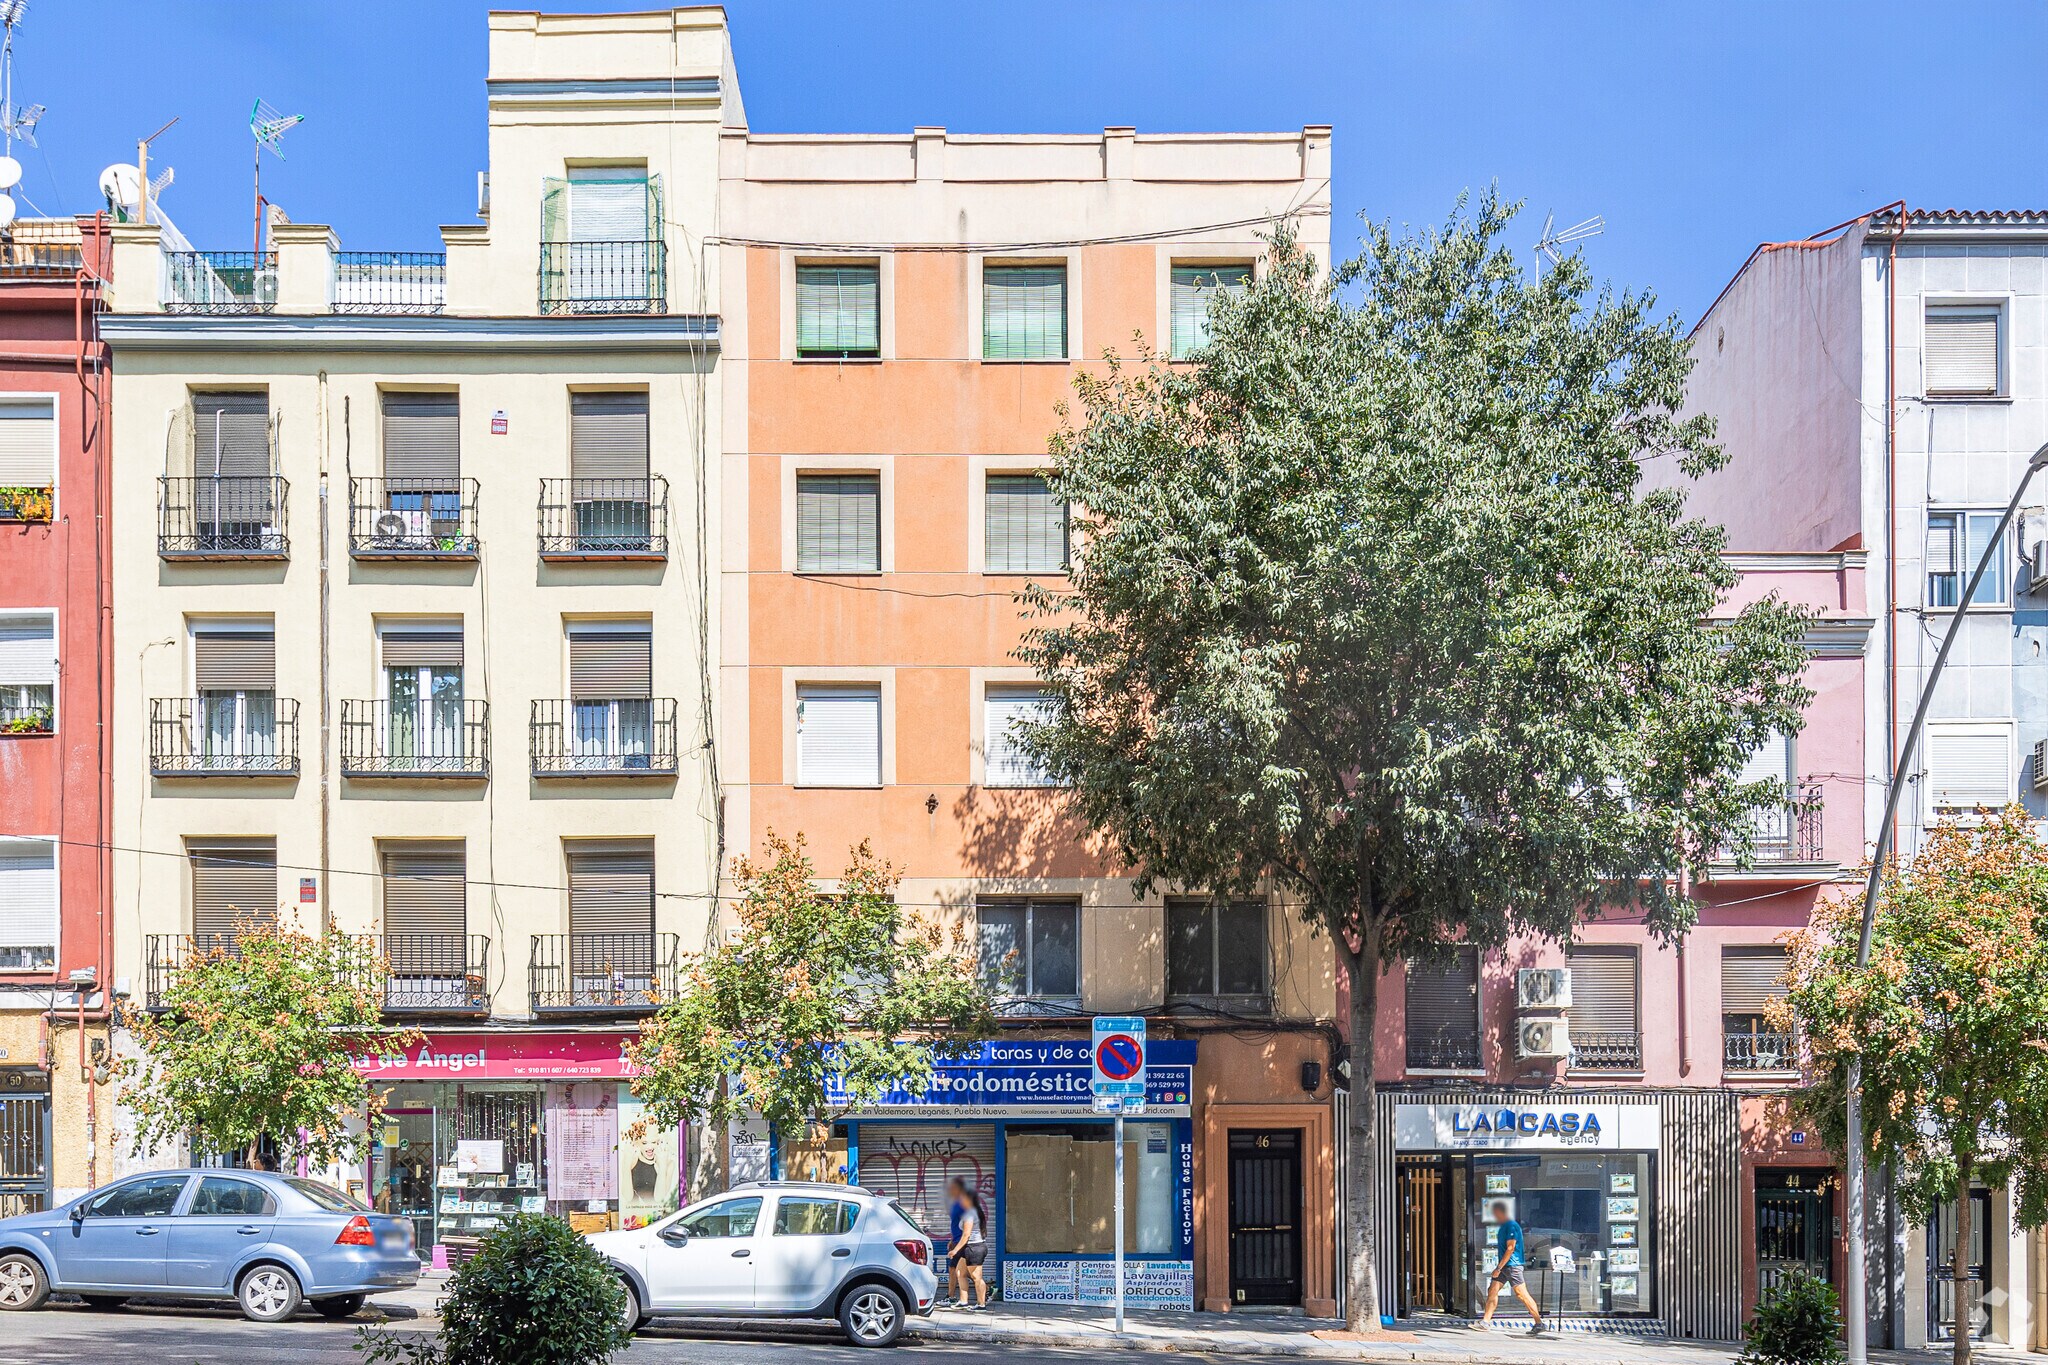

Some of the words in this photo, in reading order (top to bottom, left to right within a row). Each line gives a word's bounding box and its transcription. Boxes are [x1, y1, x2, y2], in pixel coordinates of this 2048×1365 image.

[415, 1045, 485, 1072] Ángel
[991, 1046, 1033, 1060] taras
[1038, 1049, 1047, 1063] y
[1052, 1045, 1073, 1060] de
[10, 1075, 21, 1086] 50
[1016, 1094, 1094, 1102] www.housefactorymad
[874, 1107, 915, 1116] Valdemoro,
[918, 1107, 951, 1117] Leganés,
[954, 1107, 981, 1115] Pueblo
[1454, 1112, 1493, 1133] LA
[1518, 1112, 1601, 1133] CASA
[1256, 1135, 1270, 1148] 46
[1560, 1135, 1600, 1146] agency
[1792, 1134, 1803, 1142] 44
[1180, 1143, 1192, 1183] House
[1785, 1174, 1800, 1187] 44
[1182, 1188, 1192, 1245] Factory
[1124, 1271, 1194, 1281] Lavavajillas
[1005, 1291, 1074, 1300] Secadoras
[1099, 1286, 1181, 1296] FRIORÍFICOS
[1159, 1303, 1191, 1311] robots
